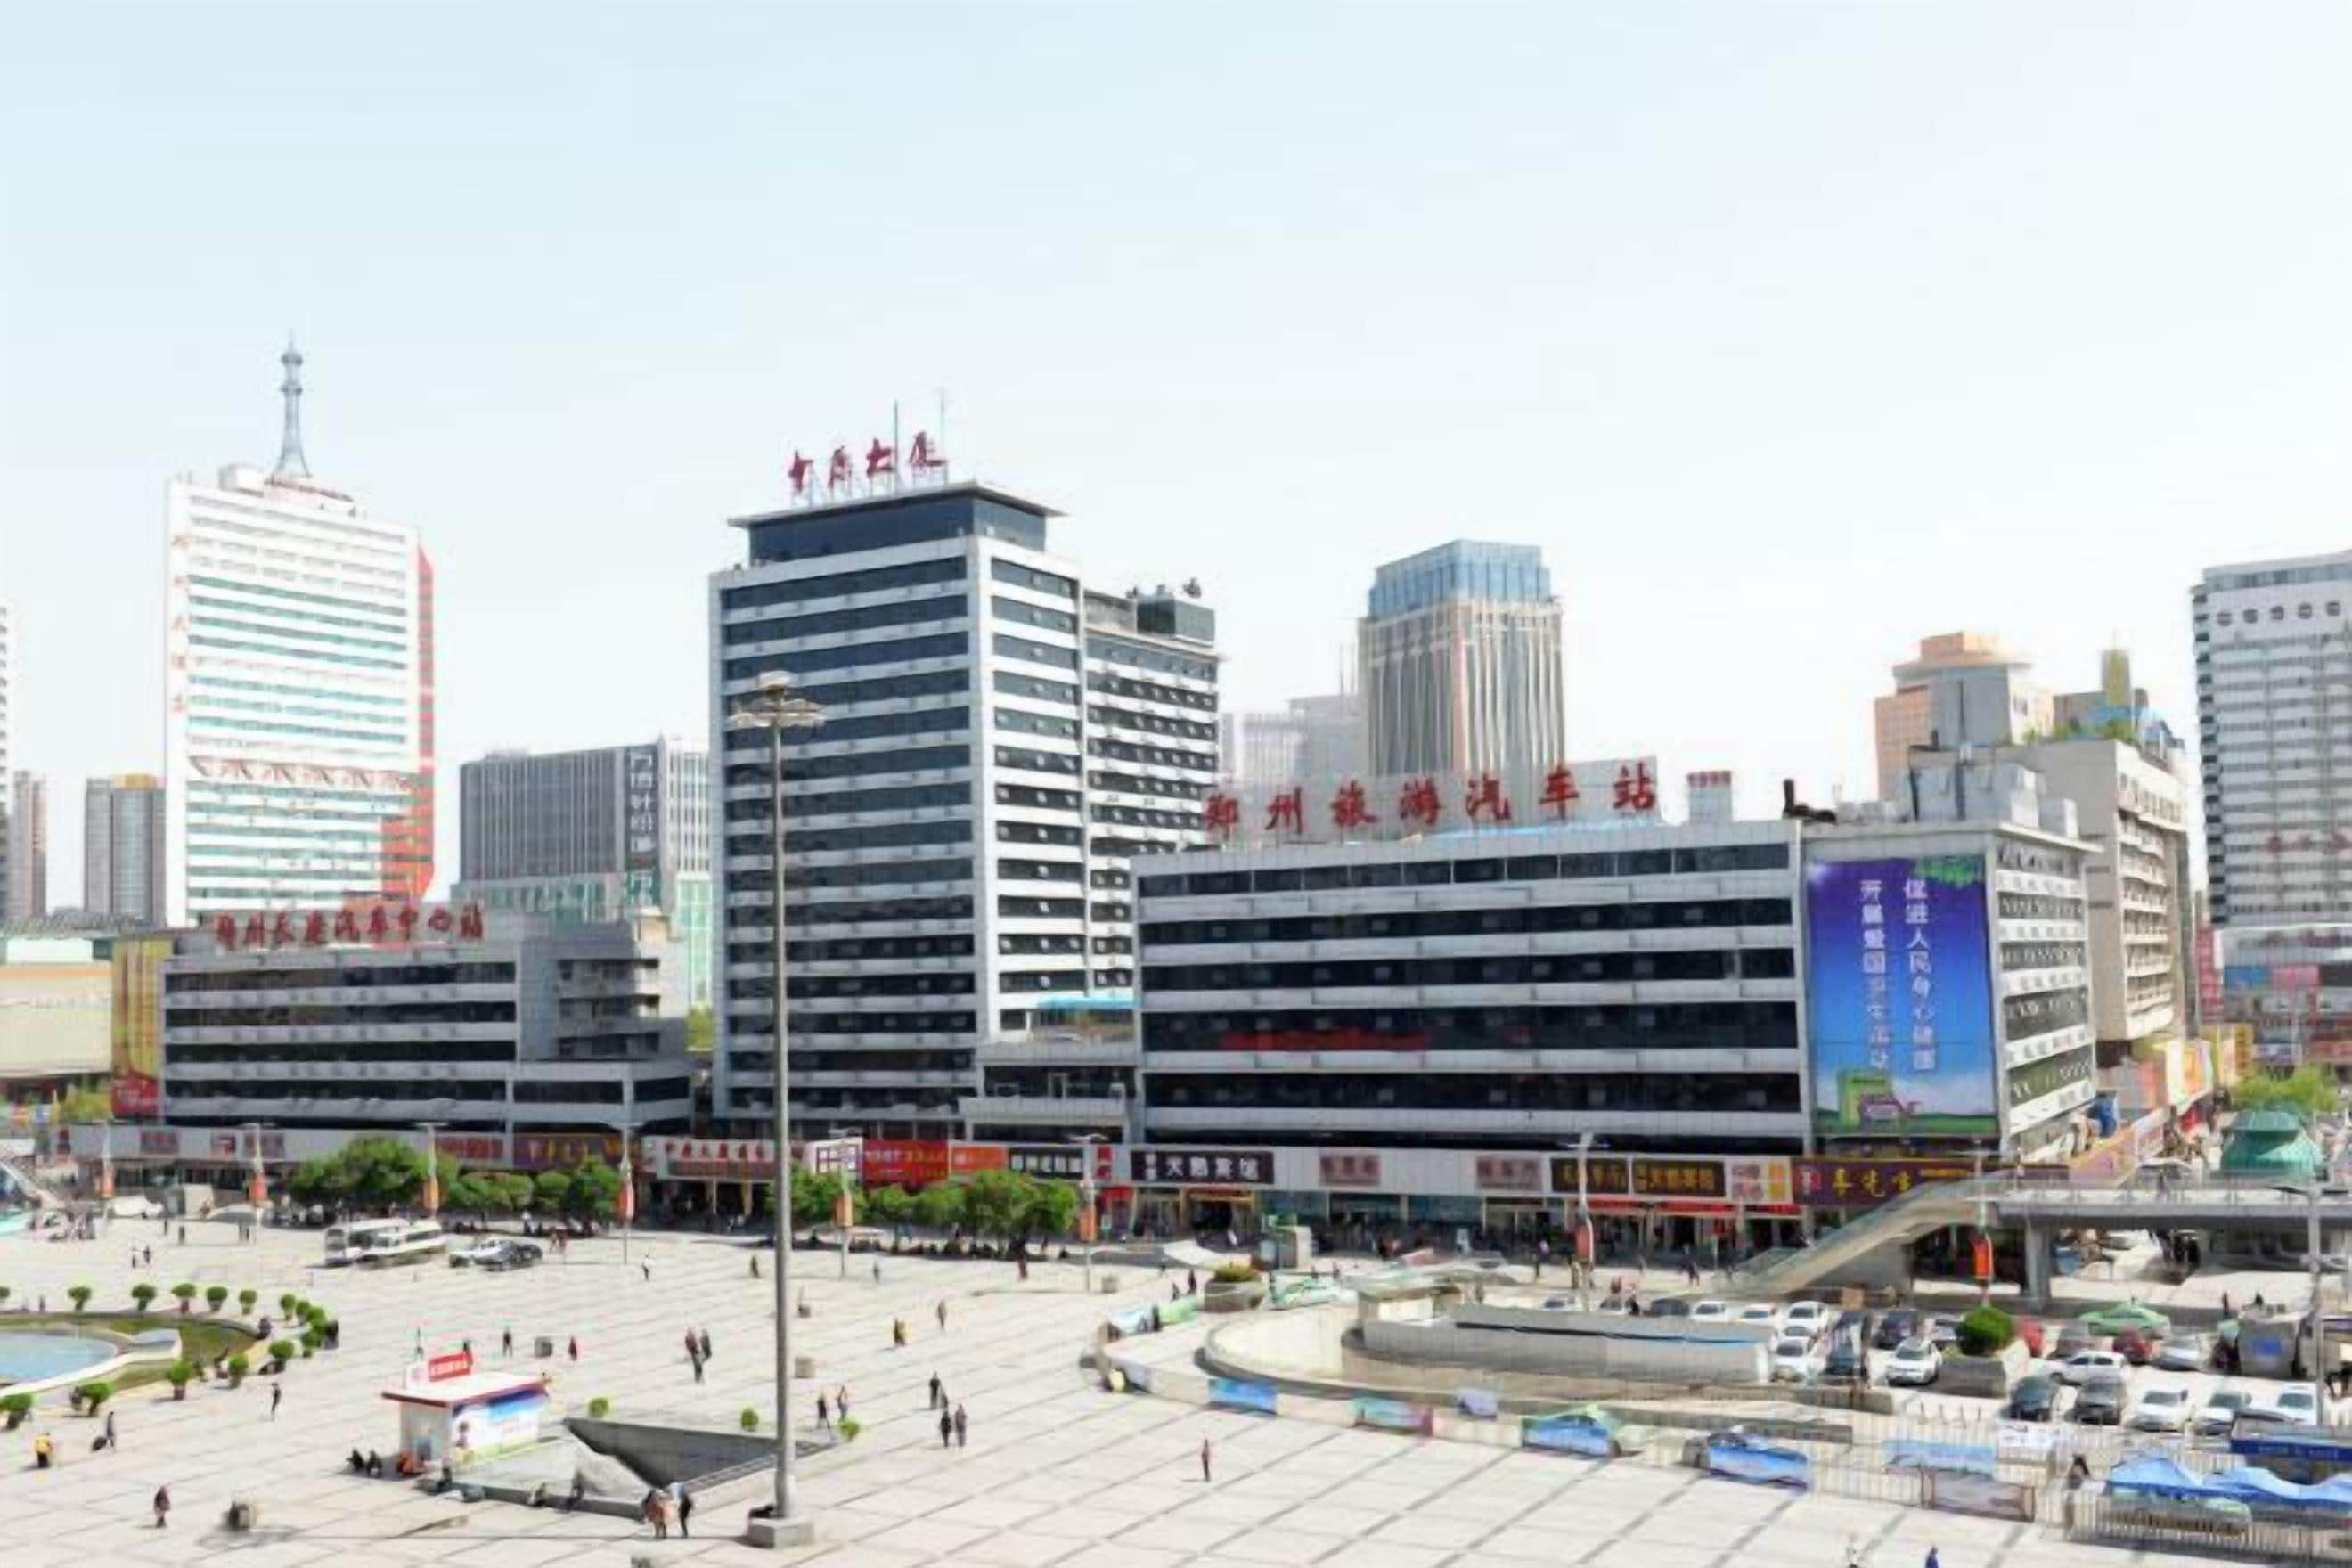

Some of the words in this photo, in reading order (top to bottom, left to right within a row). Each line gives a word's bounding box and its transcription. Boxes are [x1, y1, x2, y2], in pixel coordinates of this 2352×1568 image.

[1205, 762, 1656, 836] 郑州旅游汽车站
